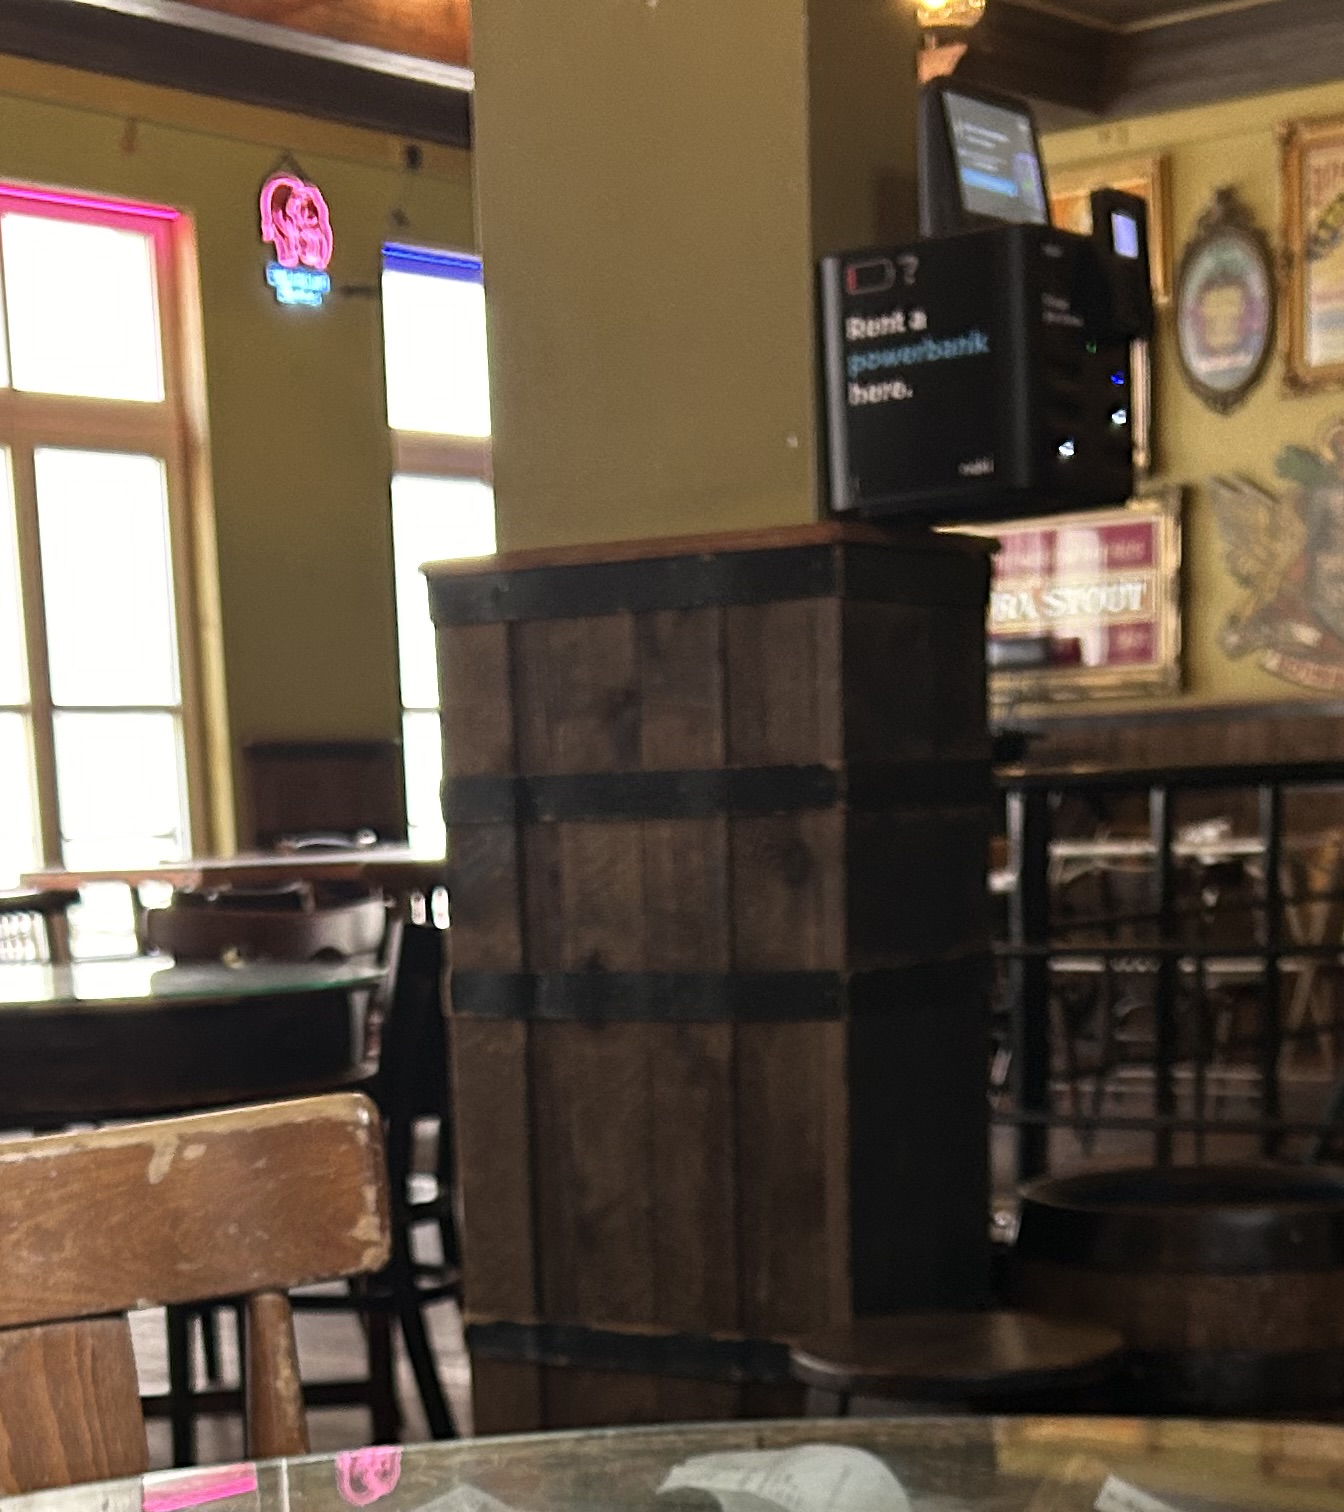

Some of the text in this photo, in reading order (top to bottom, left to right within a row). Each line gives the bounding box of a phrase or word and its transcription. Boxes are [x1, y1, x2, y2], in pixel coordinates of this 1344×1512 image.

[846, 310, 927, 340] Rent a
[847, 330, 988, 377] powerbank
[848, 381, 913, 405] here.
[1042, 581, 1145, 616] STOUT
